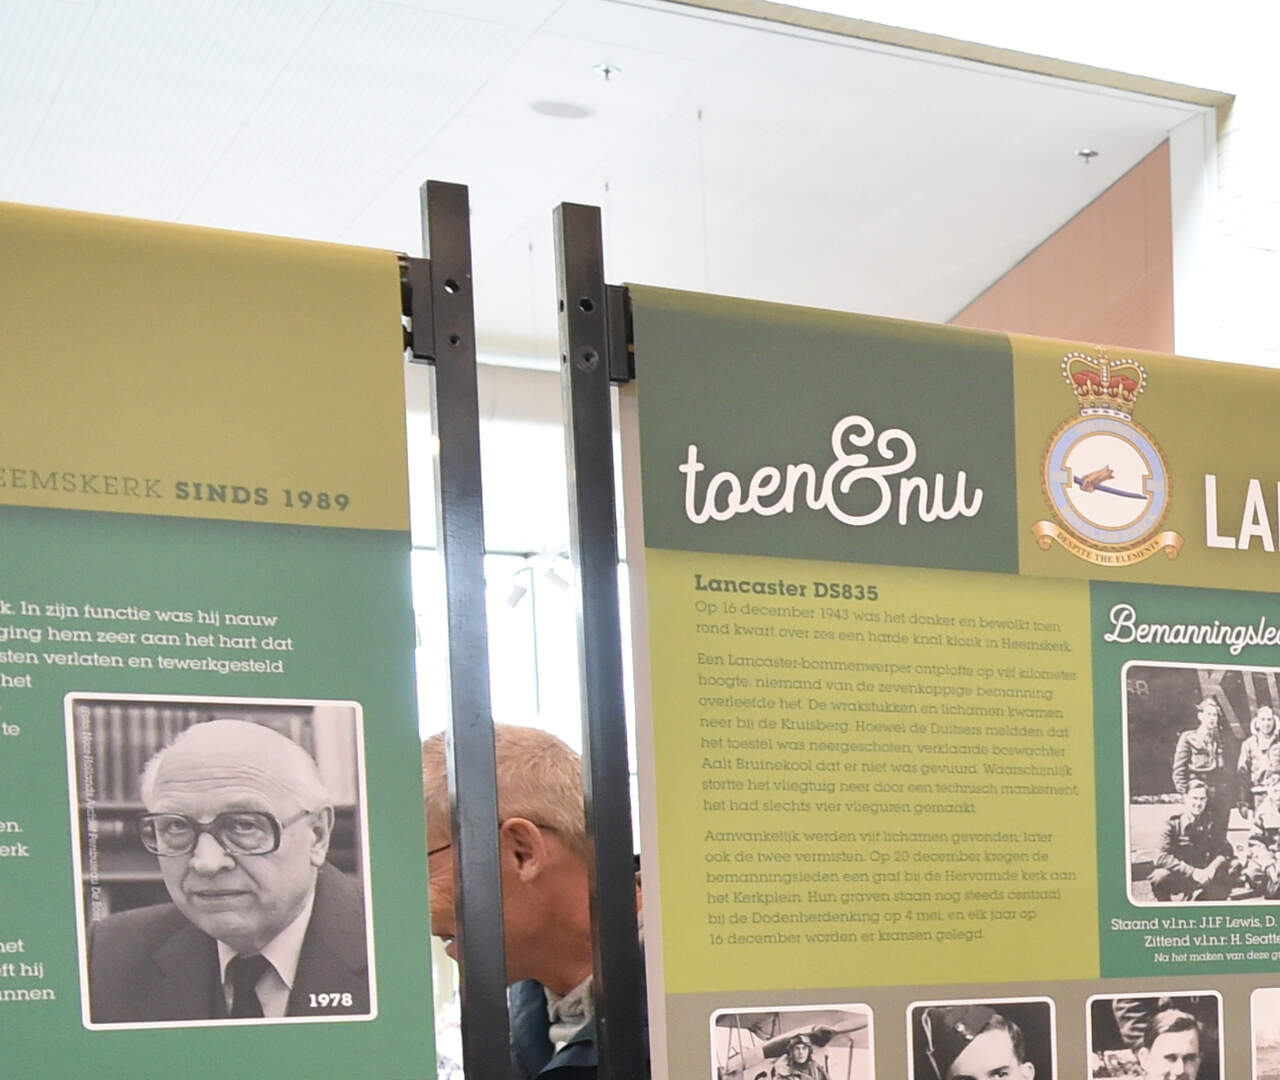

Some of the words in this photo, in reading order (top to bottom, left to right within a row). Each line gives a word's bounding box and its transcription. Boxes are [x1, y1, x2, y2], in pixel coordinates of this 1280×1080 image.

[175, 481, 268, 505] SINDS
[283, 489, 349, 511] 1989
[695, 574, 807, 597] Lancaster
[813, 581, 878, 601] DS835
[20, 601, 41, 615] In
[45, 603, 79, 619] zijn
[84, 604, 151, 620] functie
[154, 610, 193, 623] was
[198, 609, 219, 626] hij
[224, 614, 278, 626] nauw
[694, 599, 718, 616] Op
[723, 601, 737, 614] 16
[740, 603, 815, 619] december
[820, 607, 849, 620] 1943
[852, 611, 880, 622] was
[883, 610, 906, 624] het
[958, 617, 976, 628] en
[1032, 621, 1062, 632] toen
[1110, 917, 1159, 930] Staand
[1161, 917, 1196, 928] v.l.n.r.
[1225, 916, 1262, 928] Lewis,
[1265, 915, 1277, 927] D.
[1144, 934, 1190, 947] Zittend
[1192, 934, 1227, 946] v.l.n.r.
[1230, 933, 1242, 945] H.
[309, 993, 353, 1008] 1978
